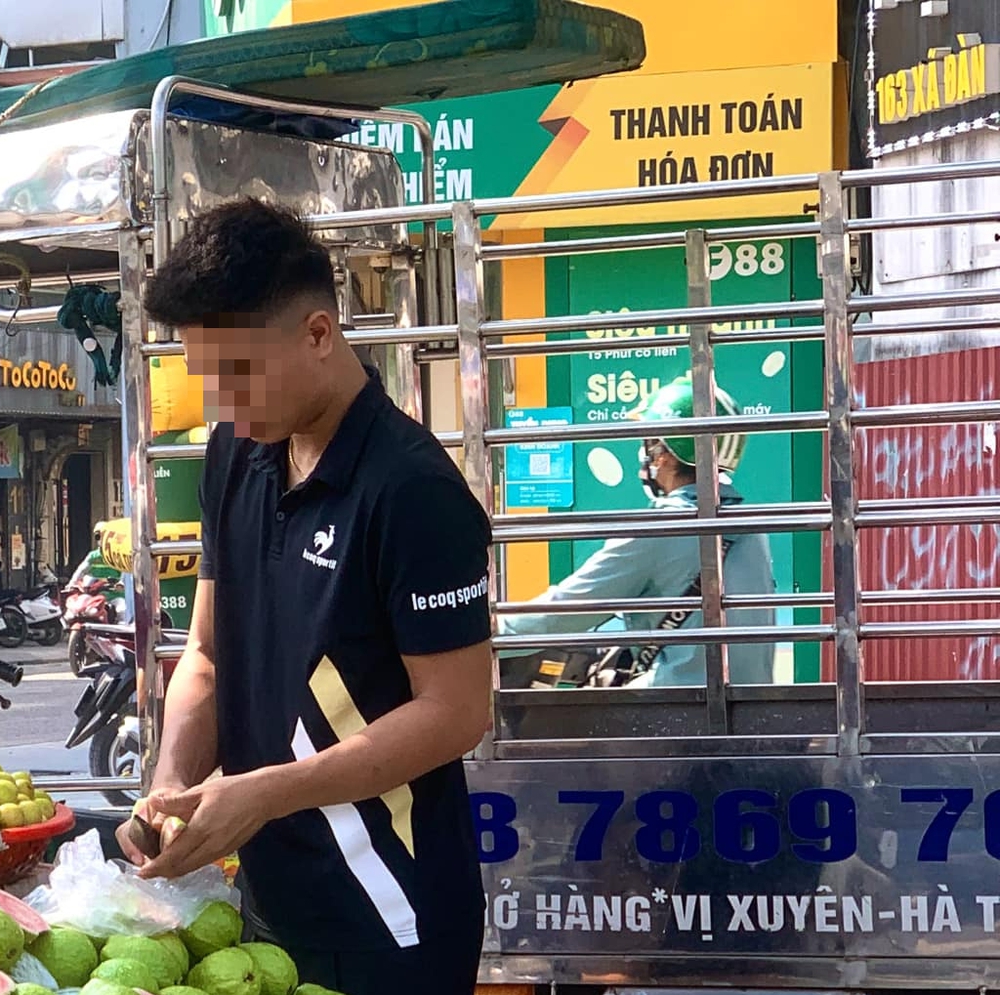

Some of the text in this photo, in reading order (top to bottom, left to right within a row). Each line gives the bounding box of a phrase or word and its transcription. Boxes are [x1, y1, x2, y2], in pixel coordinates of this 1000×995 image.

[876, 69, 908, 125] 163
[610, 97, 803, 141] THANH TOÁN
[637, 151, 774, 188] HÓA ĐƠN
[587, 370, 660, 404] Siêu
[158, 596, 187, 609] 388
[411, 593, 427, 611] le
[428, 591, 457, 608] coq
[558, 788, 858, 865] 7869
[900, 788, 1000, 863] 7
[484, 878, 520, 931] Ở
